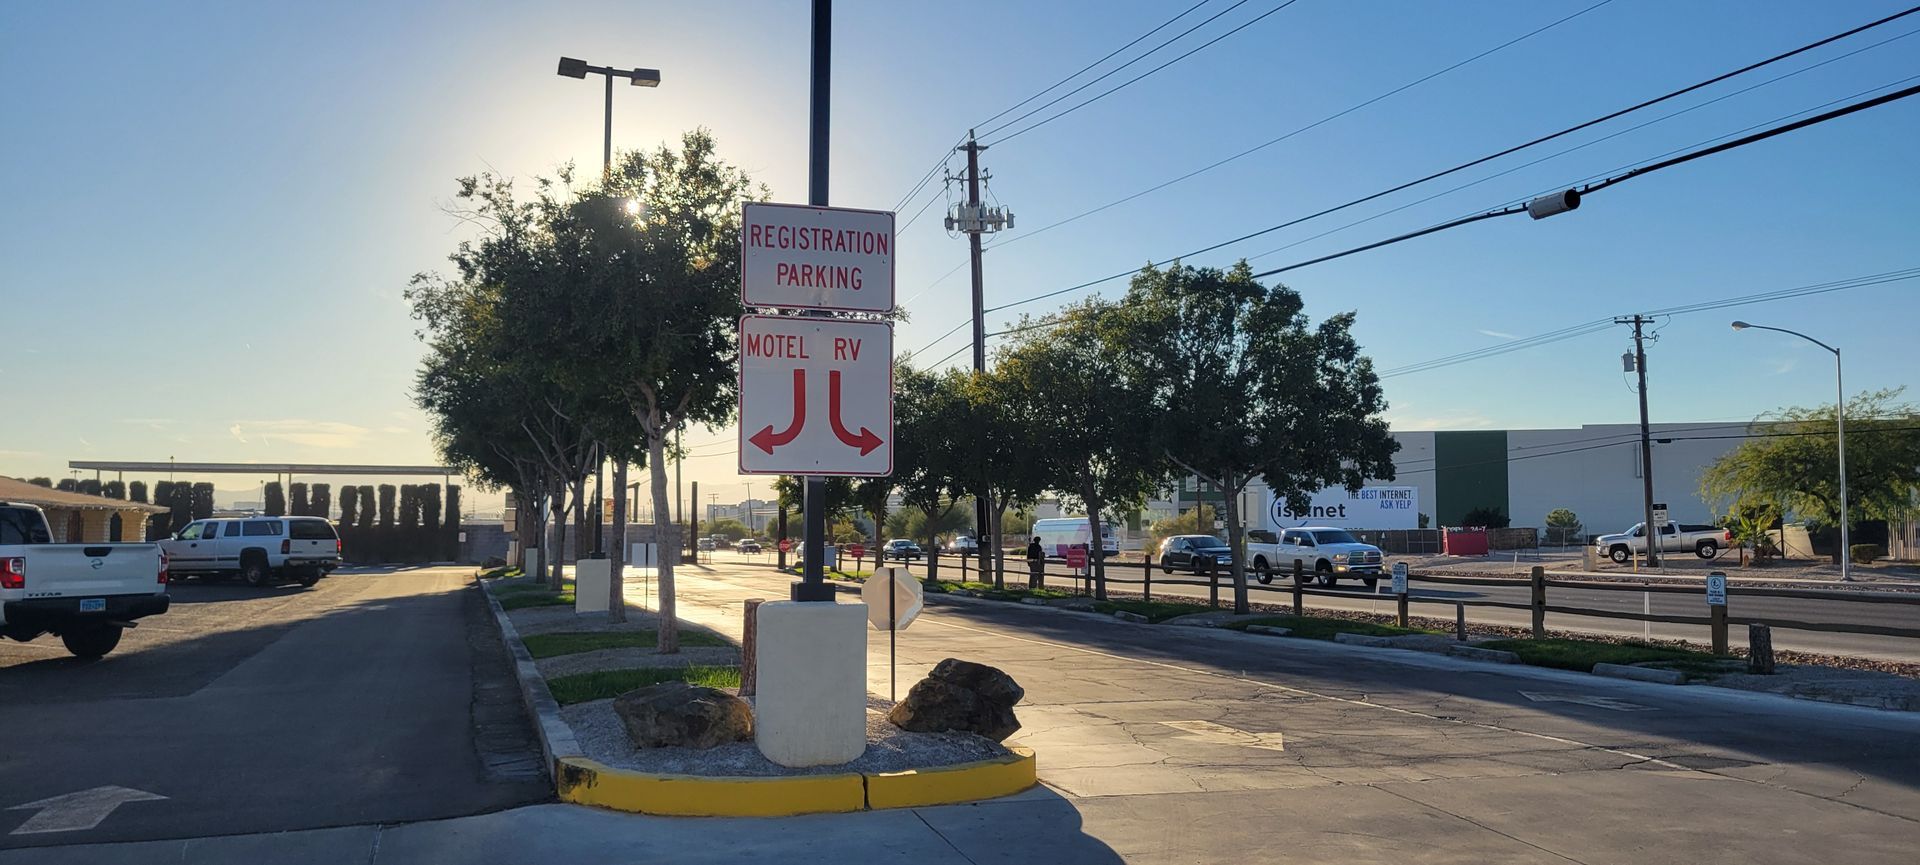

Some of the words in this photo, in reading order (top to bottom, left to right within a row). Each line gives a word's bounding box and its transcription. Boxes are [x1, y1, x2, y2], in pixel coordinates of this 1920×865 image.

[750, 224, 888, 256] REGISTRATION
[777, 263, 862, 291] PARKING
[747, 333, 809, 359] MOTEL
[834, 338, 862, 361] RV
[1348, 490, 1360, 500] THE
[1361, 490, 1378, 500] BEST
[1379, 490, 1414, 500] INTERNET.
[1380, 499, 1393, 510] ASK
[1395, 499, 1412, 510] YELP
